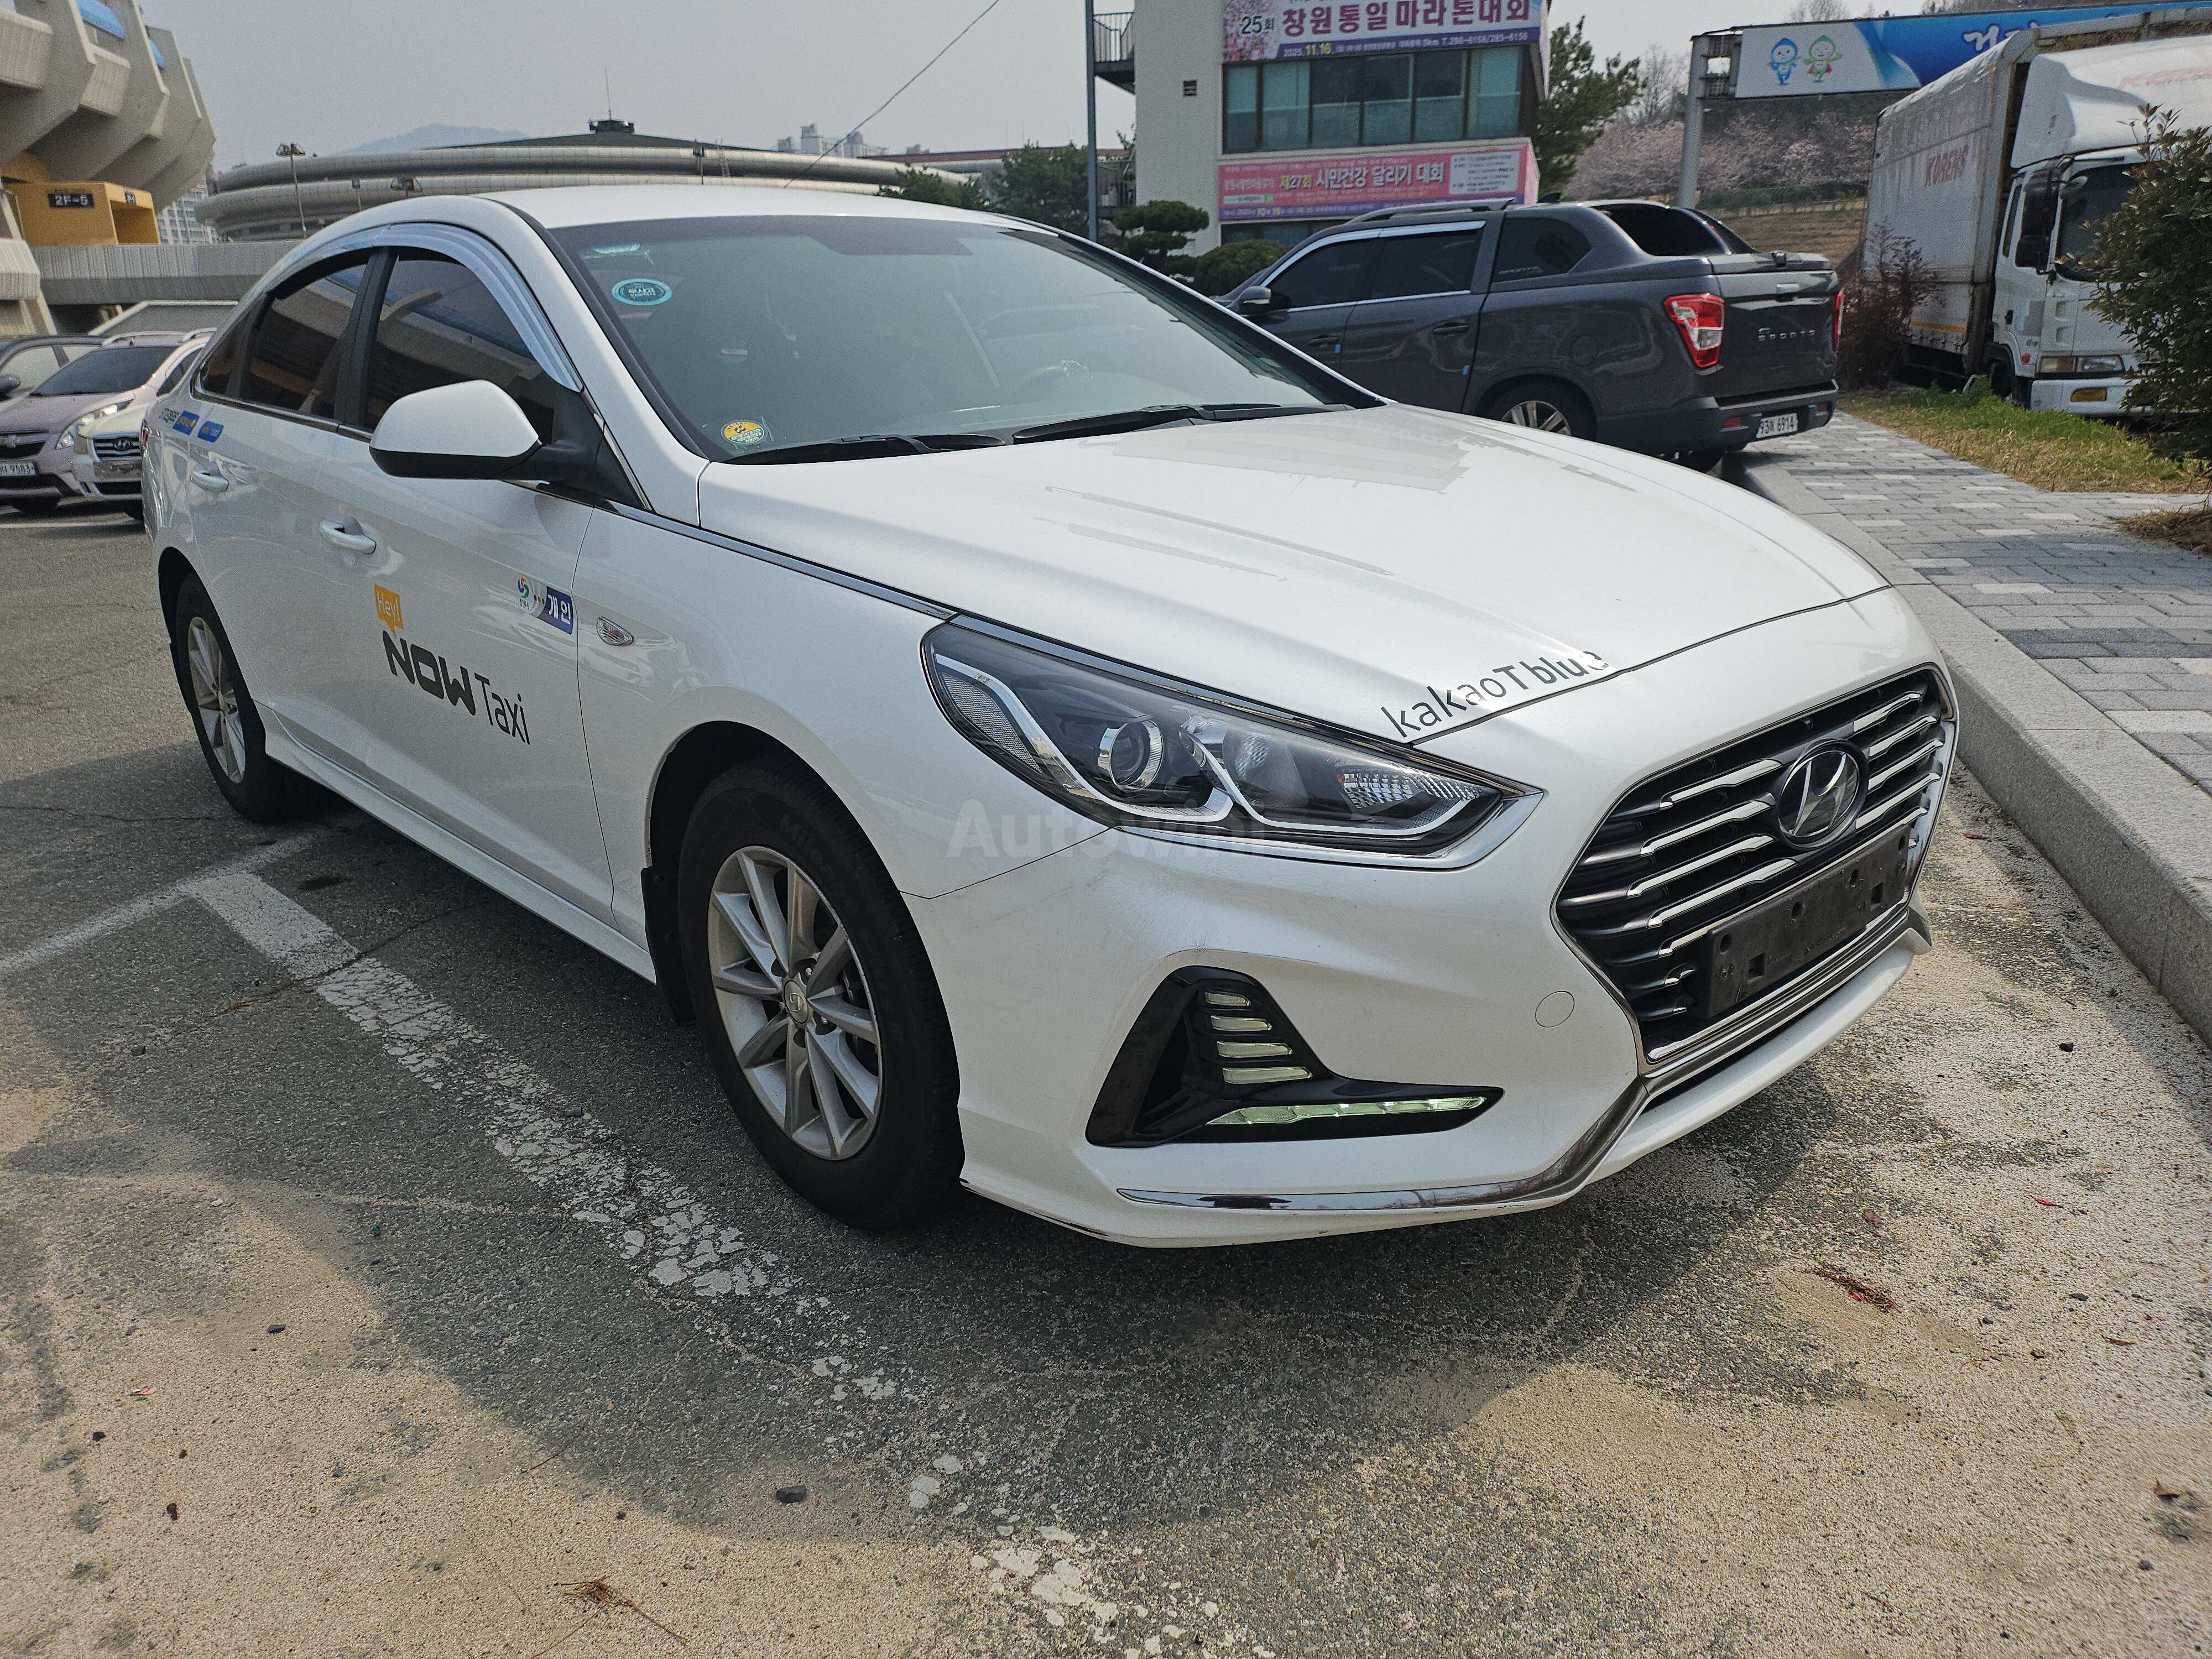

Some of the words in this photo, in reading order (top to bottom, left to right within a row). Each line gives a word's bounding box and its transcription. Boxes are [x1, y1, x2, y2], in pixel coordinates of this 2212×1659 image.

[1316, 167, 1369, 189] 시민건강
[1371, 165, 1412, 187] 달리기
[1416, 163, 1445, 184] 대회
[547, 594, 571, 625] 개인
[382, 630, 476, 716] NOW
[474, 672, 531, 745] Taxi
